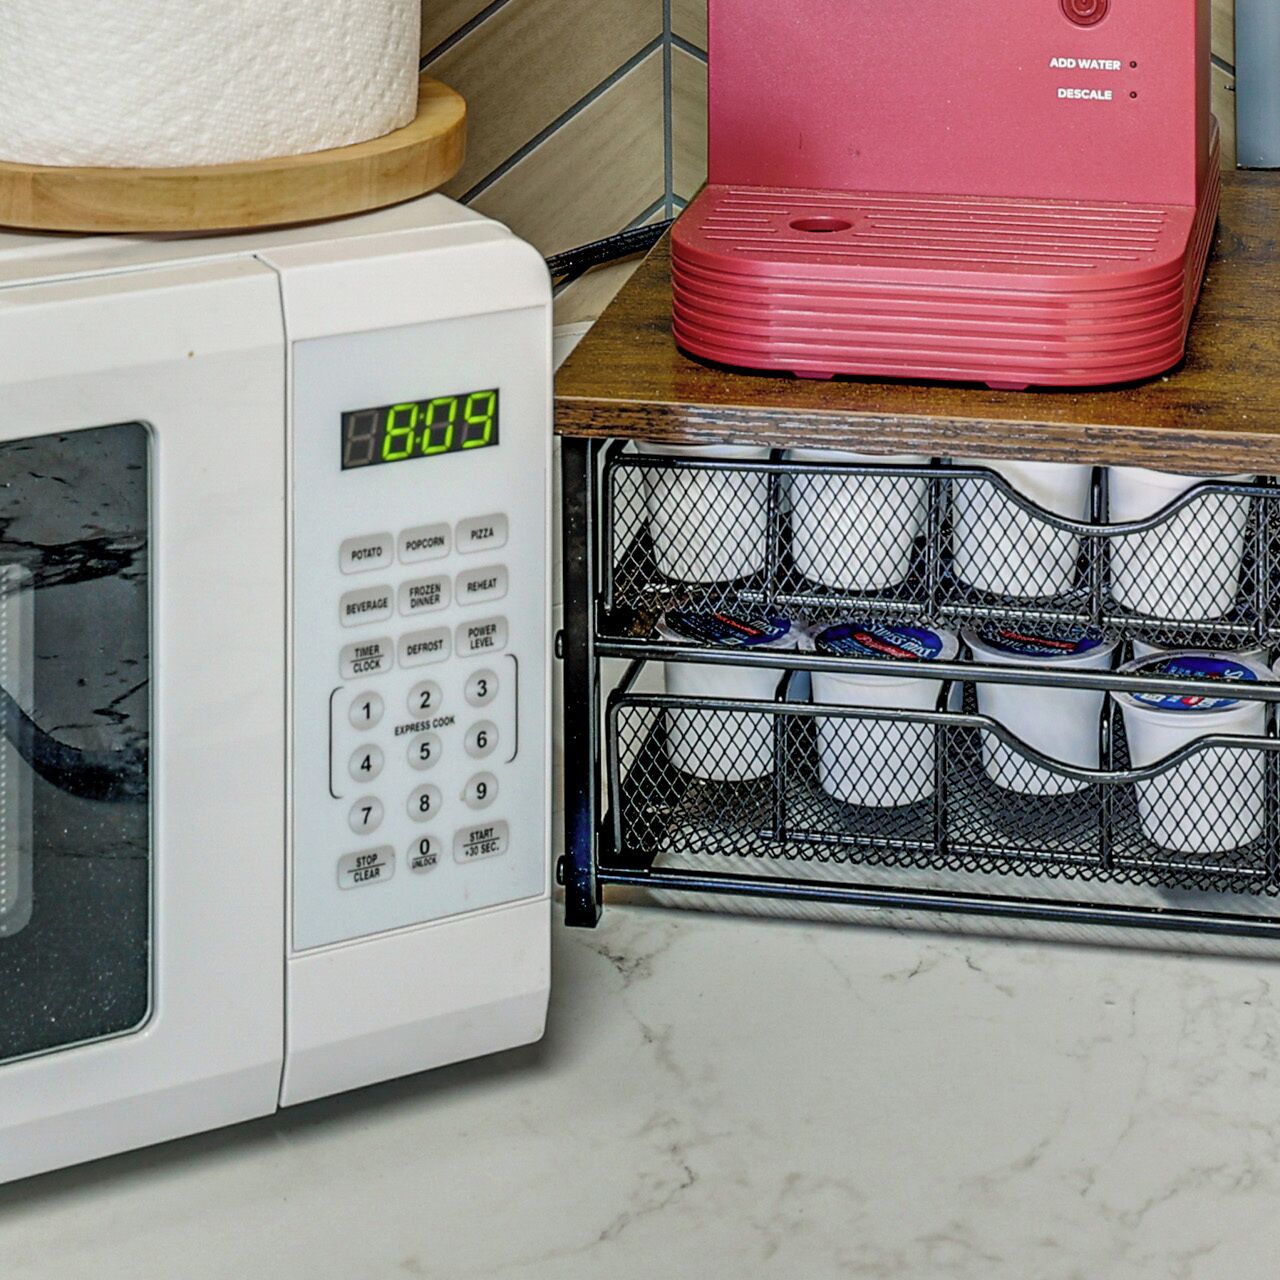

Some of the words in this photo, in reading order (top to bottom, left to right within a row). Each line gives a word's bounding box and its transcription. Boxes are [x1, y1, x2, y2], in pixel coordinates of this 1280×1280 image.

[1050, 58, 1076, 69] ADD
[1079, 58, 1121, 70] WATER
[1057, 88, 1112, 100] DESCALE
[382, 391, 496, 461] 8:09
[471, 527, 493, 540] PIZZA
[406, 536, 444, 551] POPCORN
[352, 546, 382, 560] POTATO
[410, 584, 441, 597] FROZEN
[468, 579, 497, 592] REHEAT
[346, 598, 388, 615] BEVERAGE
[411, 594, 440, 608] DINNER
[469, 625, 496, 637] POWER
[407, 640, 443, 655] DEFROST
[471, 637, 494, 649] LEVEL
[355, 645, 379, 657] TIMER
[354, 660, 381, 673] CLOCK
[477, 680, 487, 697] 3
[420, 691, 430, 709] 2
[363, 703, 370, 720] 1
[395, 721, 430, 736] EXPRESS
[433, 716, 455, 728] COOK
[477, 731, 487, 748] 6
[420, 743, 430, 760] 5
[361, 755, 371, 772] 4
[477, 782, 486, 800] 9
[420, 795, 430, 812] 8
[362, 807, 372, 824] 7
[470, 828, 493, 842] START
[420, 839, 430, 855] 0
[481, 841, 499, 854] SEC.
[356, 854, 377, 867] STOP
[411, 857, 437, 868] UNLOCK
[354, 869, 380, 882] CLEAR
